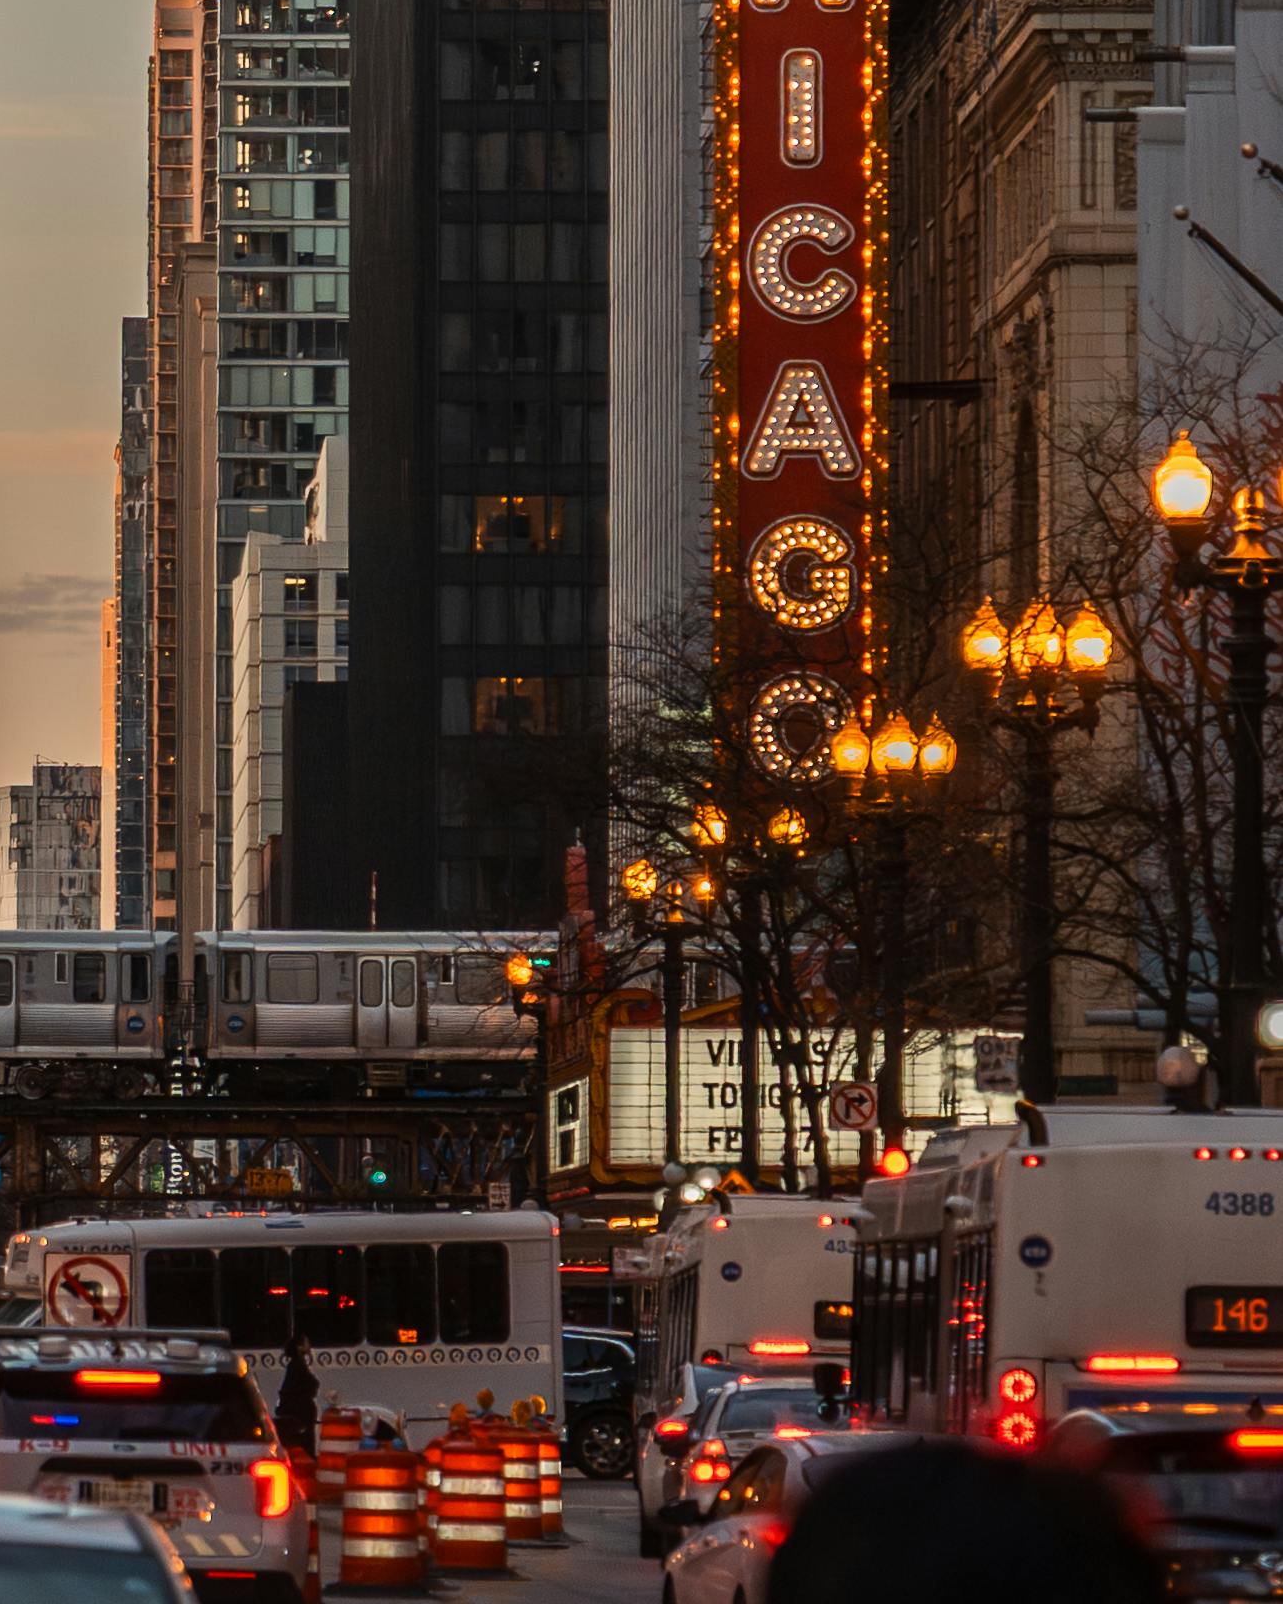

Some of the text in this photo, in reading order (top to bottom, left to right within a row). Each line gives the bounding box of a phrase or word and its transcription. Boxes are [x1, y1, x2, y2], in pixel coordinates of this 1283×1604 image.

[1205, 1191, 1275, 1217] 4388
[1212, 1298, 1269, 1332] 146
[19, 1439, 70, 1453] K-9
[168, 1440, 229, 1458] UNIT
